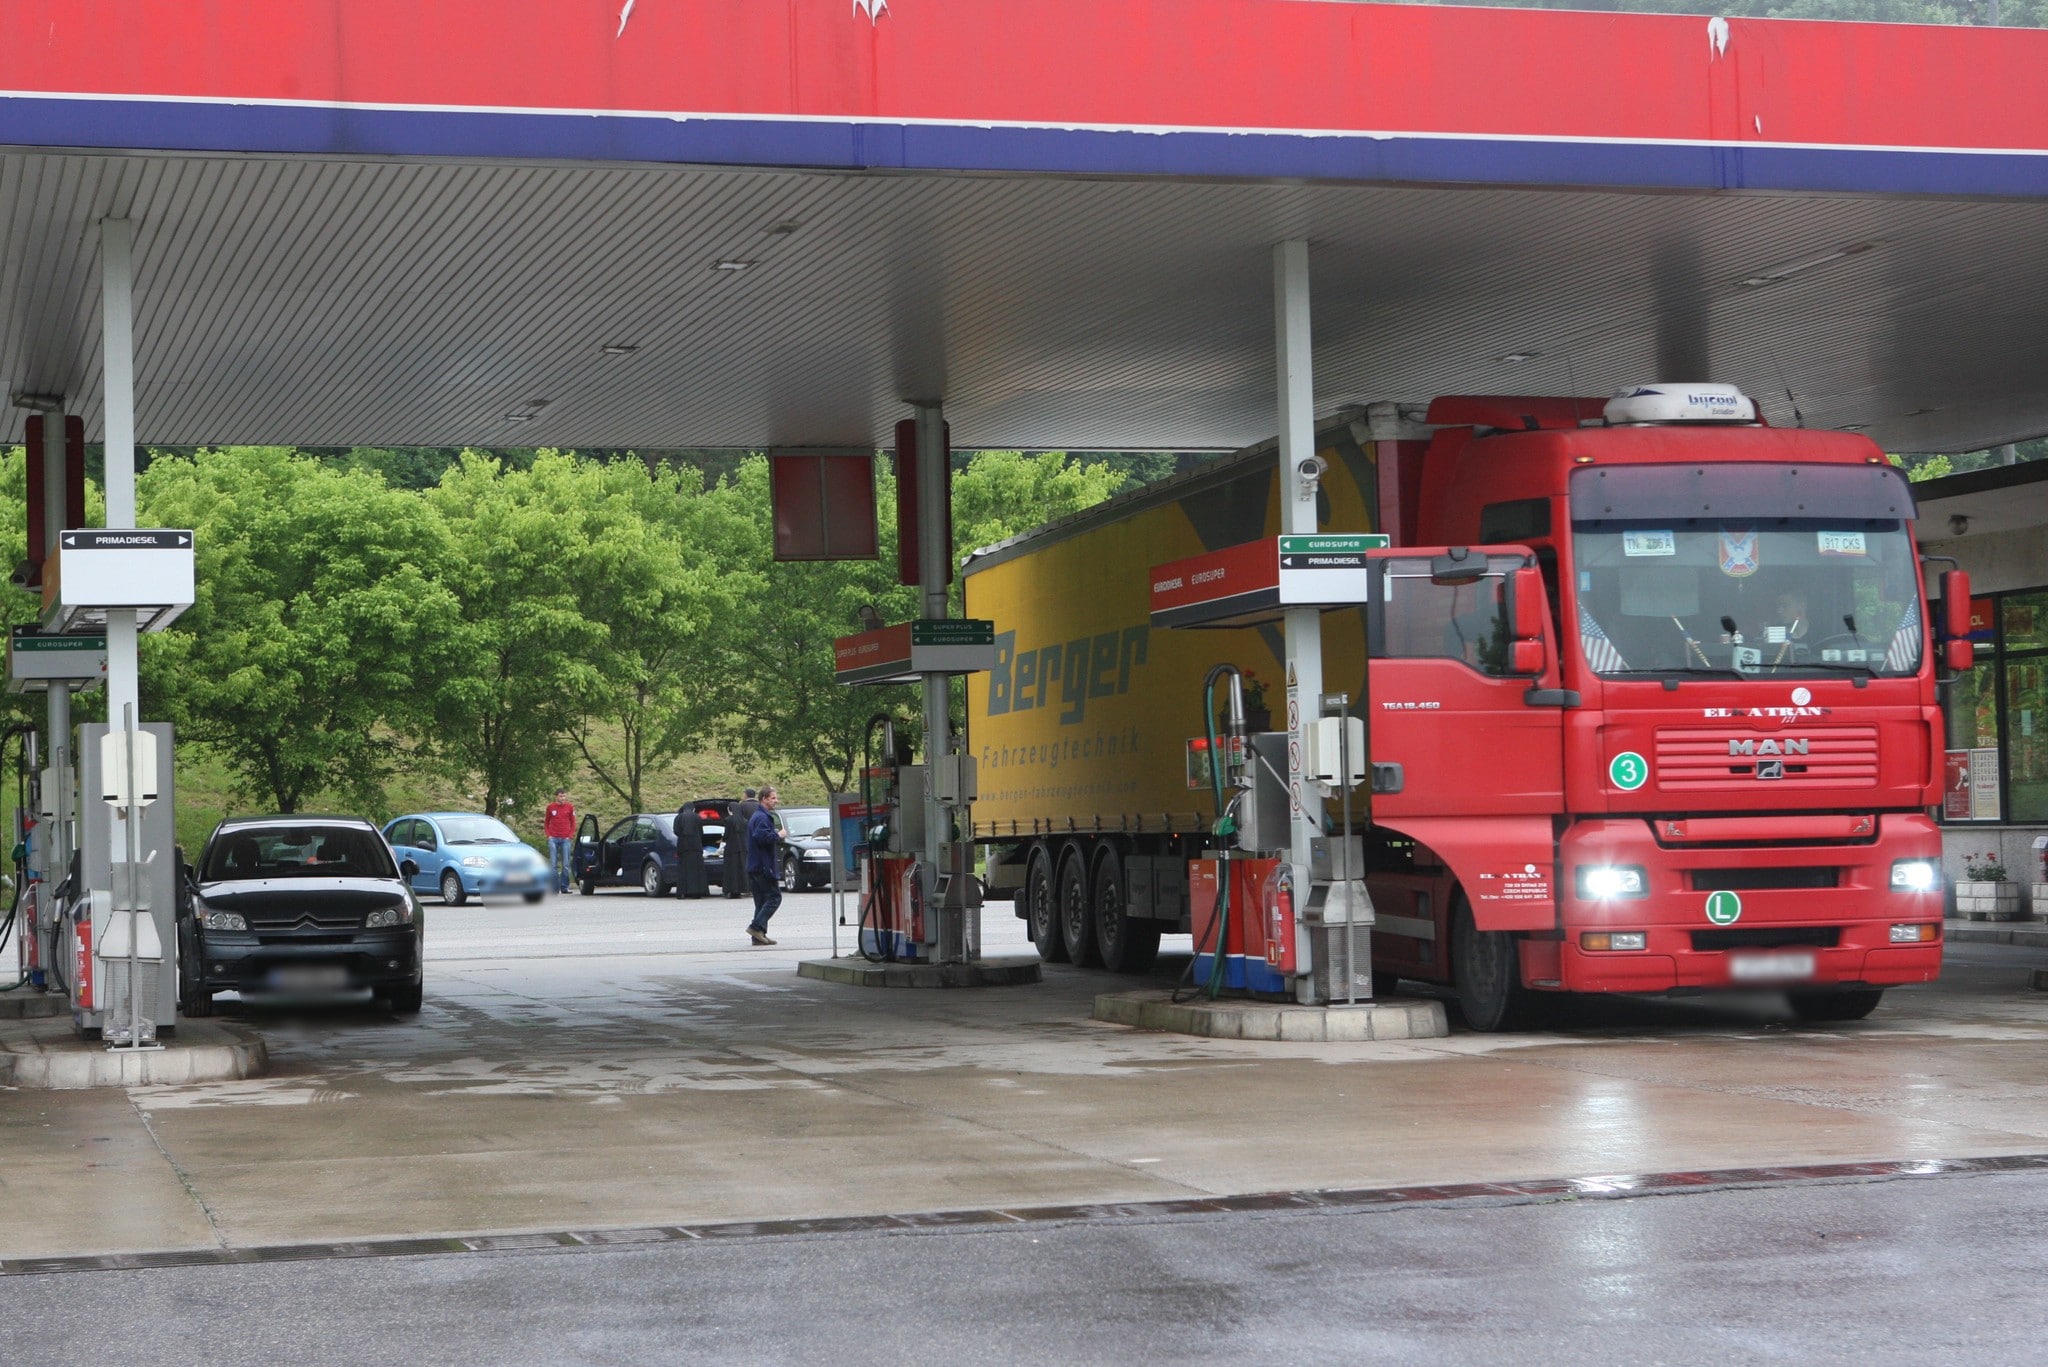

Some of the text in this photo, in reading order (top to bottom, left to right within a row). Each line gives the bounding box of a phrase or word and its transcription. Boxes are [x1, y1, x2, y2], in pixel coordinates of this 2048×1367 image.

[1688, 394, 1738, 408] bycool
[1308, 540, 1361, 548] EUROSUPER
[1153, 568, 1225, 593] EURODIESEL EUROSUPER
[988, 623, 1150, 727] Berger
[982, 726, 1140, 769] Fahrzeugtechnik
[1728, 738, 1809, 756] MAN
[1621, 760, 1637, 782] 3
[1715, 895, 1731, 919] L
